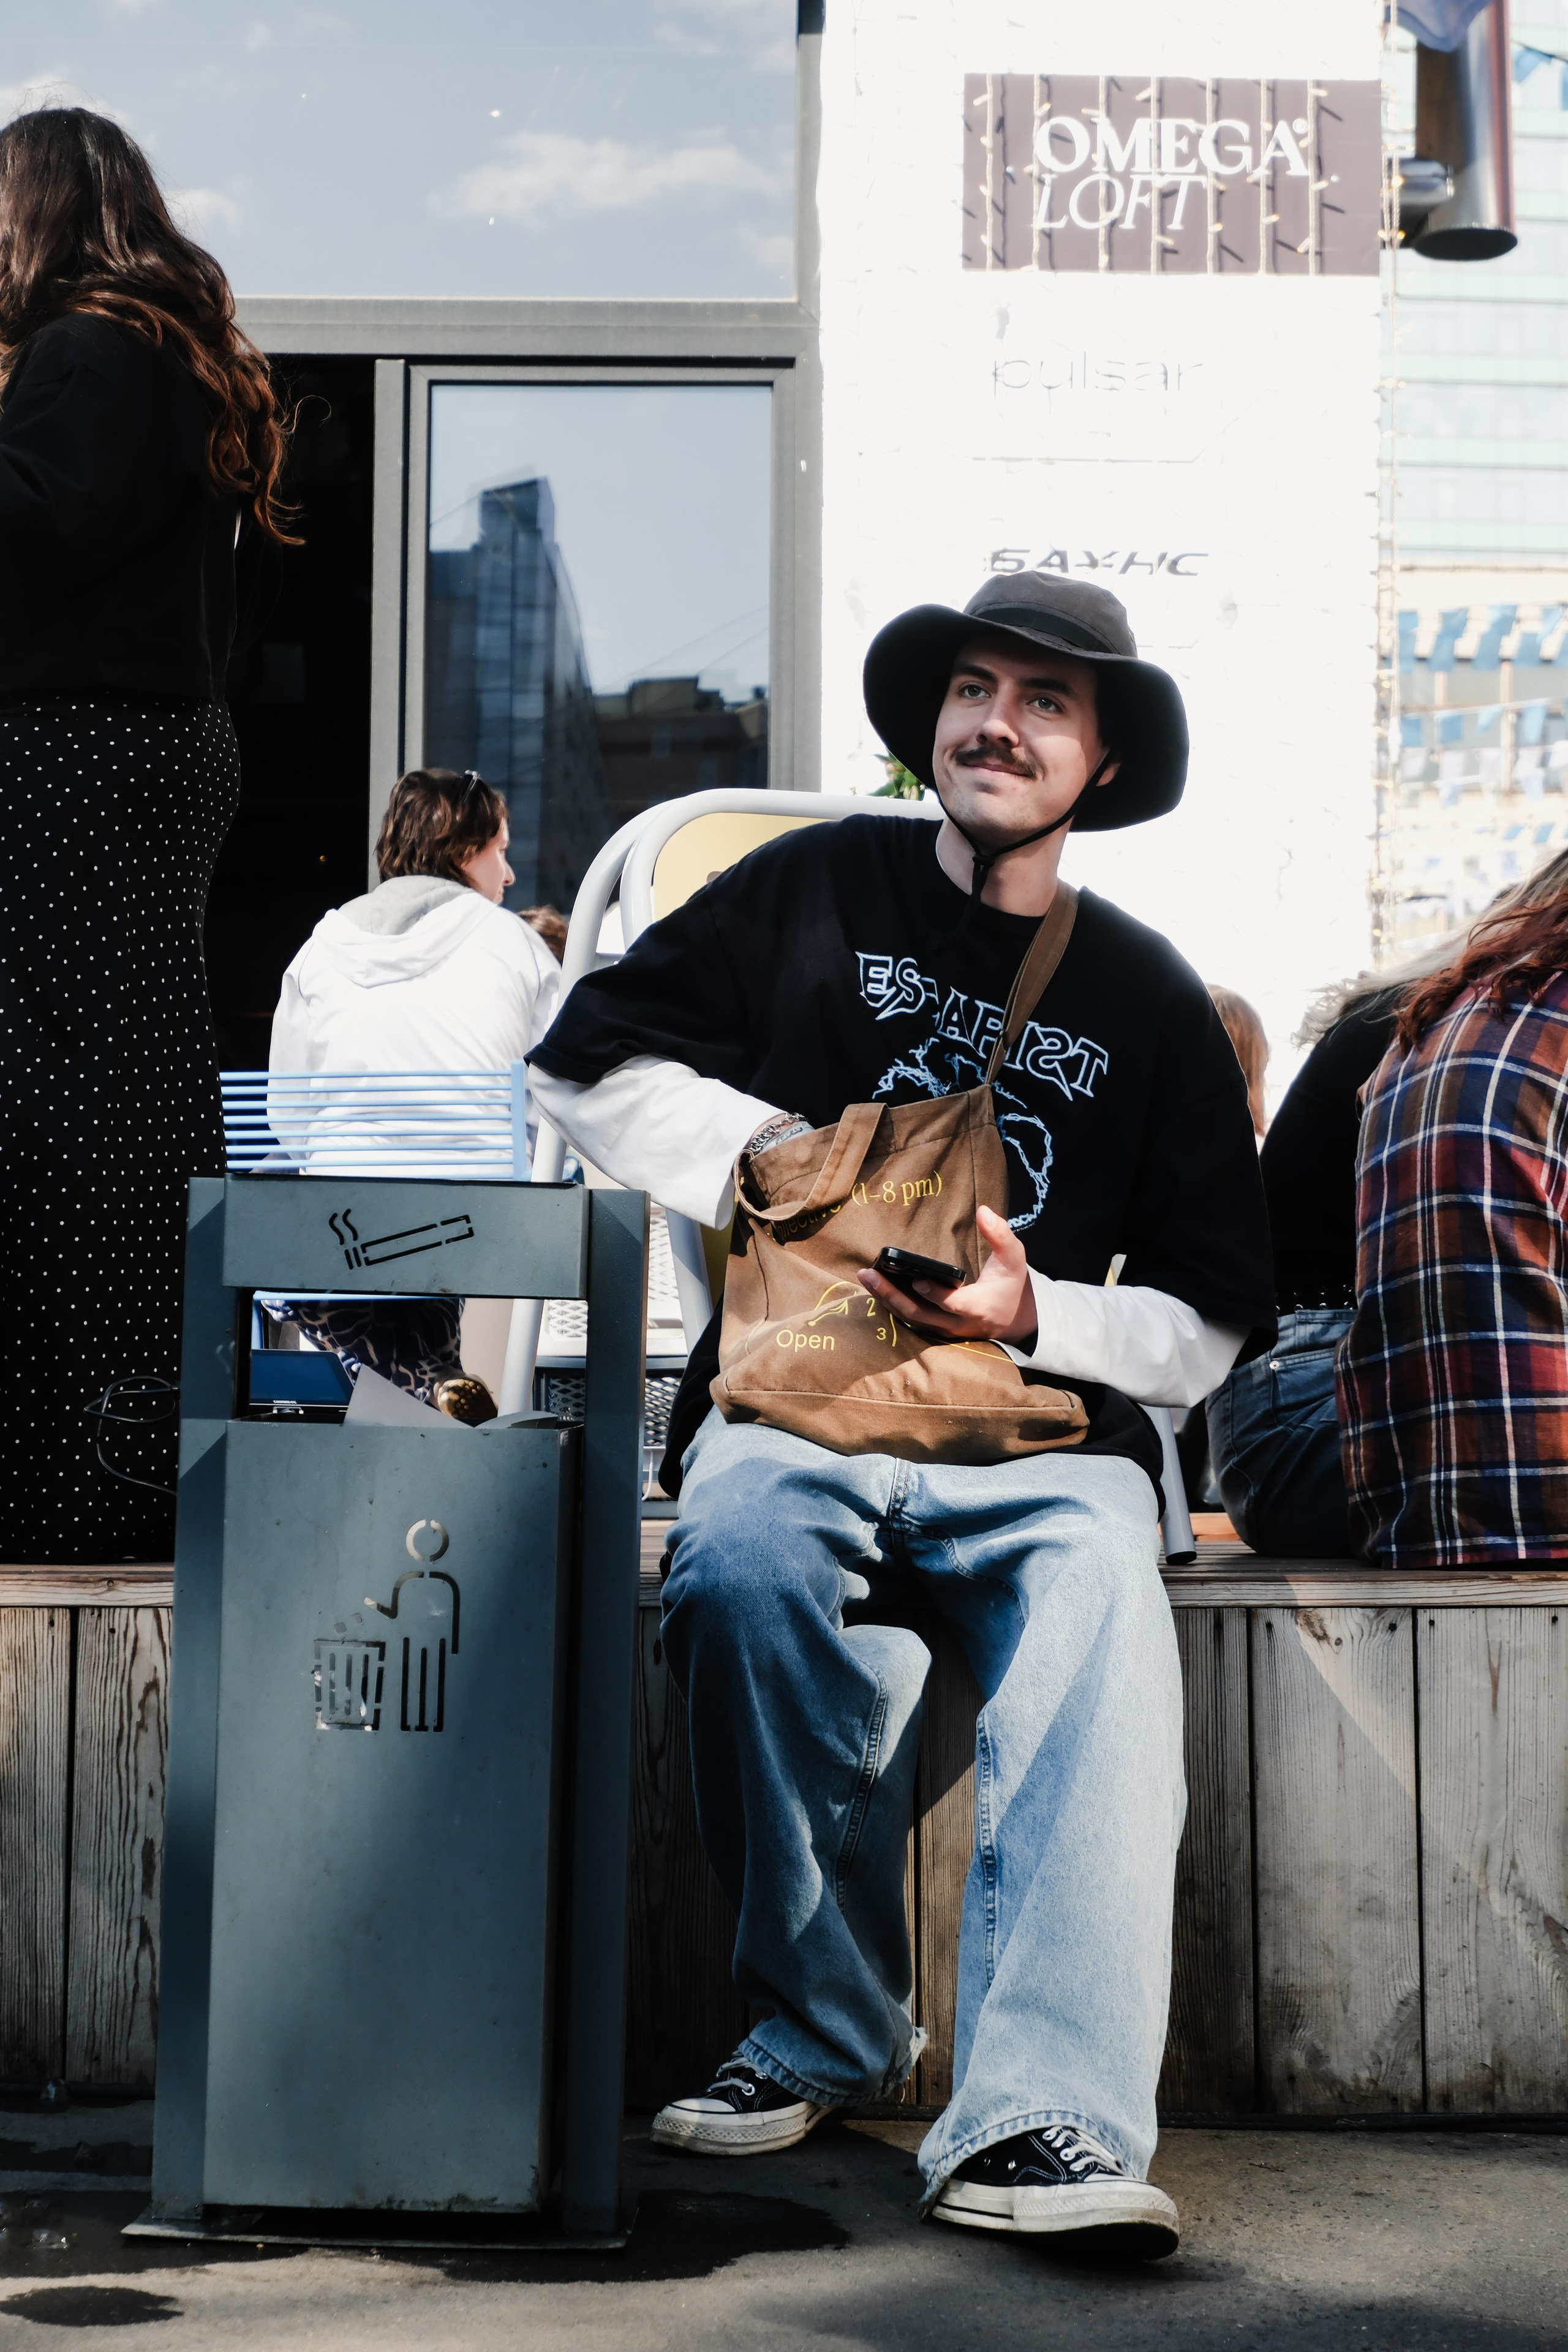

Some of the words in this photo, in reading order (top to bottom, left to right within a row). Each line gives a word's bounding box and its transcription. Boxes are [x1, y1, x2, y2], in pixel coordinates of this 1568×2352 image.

[1033, 116, 1310, 176] OMEGA
[1032, 173, 1207, 230] LOFT
[992, 350, 1203, 399] pulsar
[900, 1170, 942, 1206] pm)
[776, 1329, 835, 1352] Open
